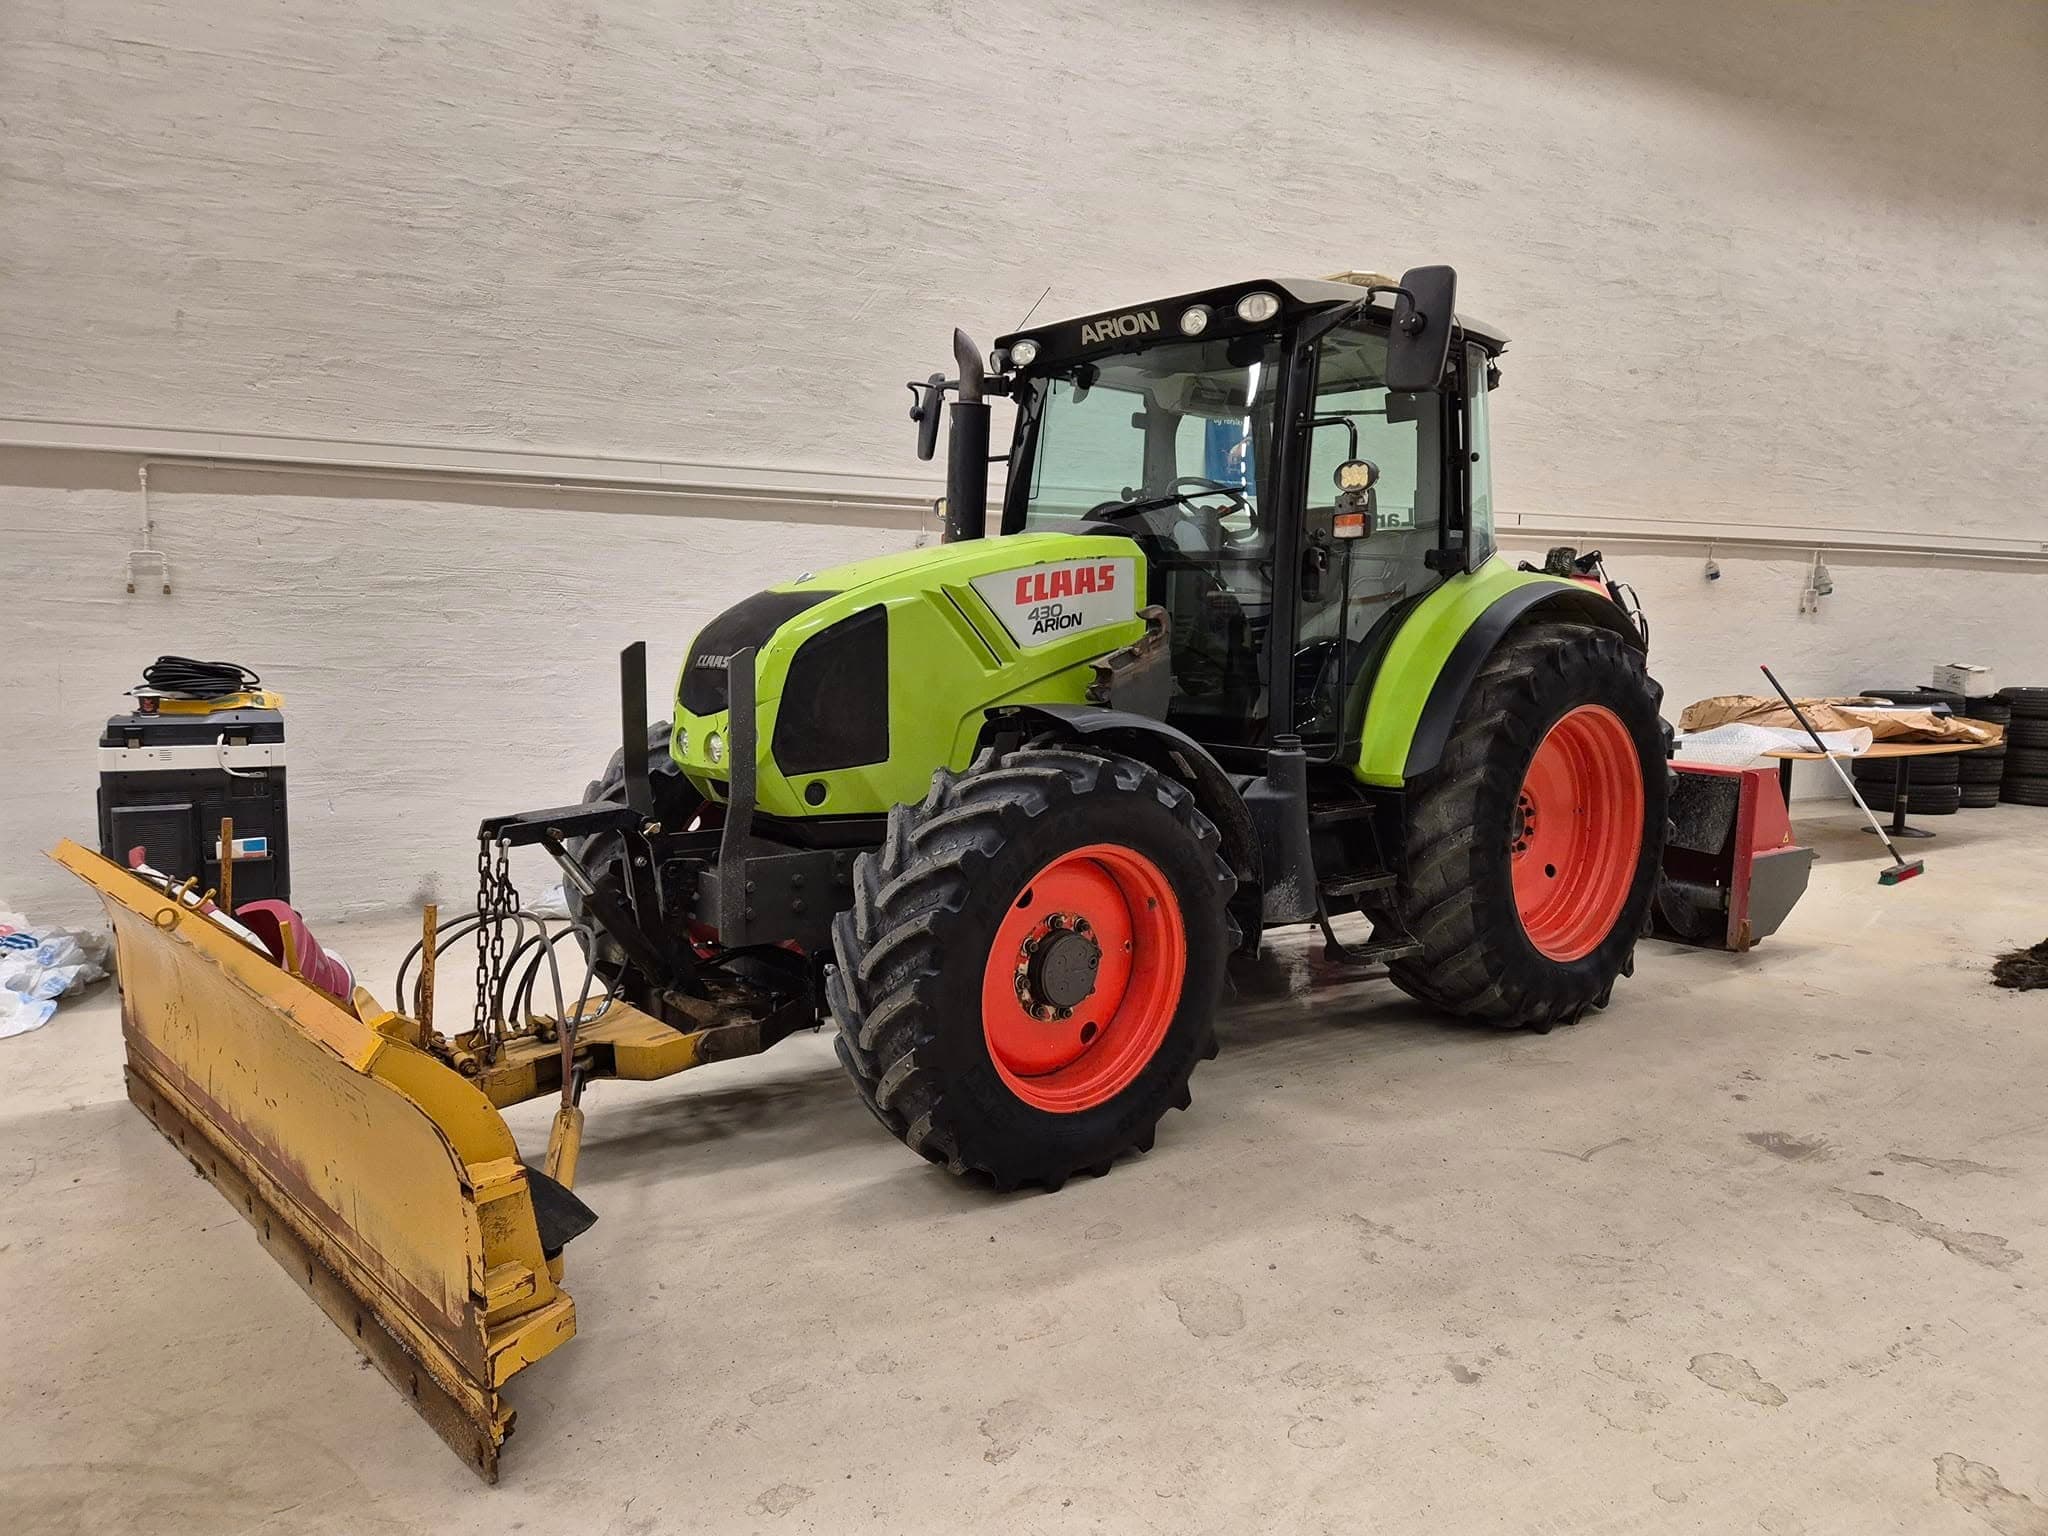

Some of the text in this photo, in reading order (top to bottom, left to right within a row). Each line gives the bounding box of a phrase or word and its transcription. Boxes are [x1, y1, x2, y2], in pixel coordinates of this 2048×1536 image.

[1081, 310, 1161, 346] ARION
[1015, 565, 1115, 606] CLAAS
[1028, 603, 1063, 621] 430
[1032, 612, 1083, 635] ARION
[696, 655, 730, 668] CLAAS
